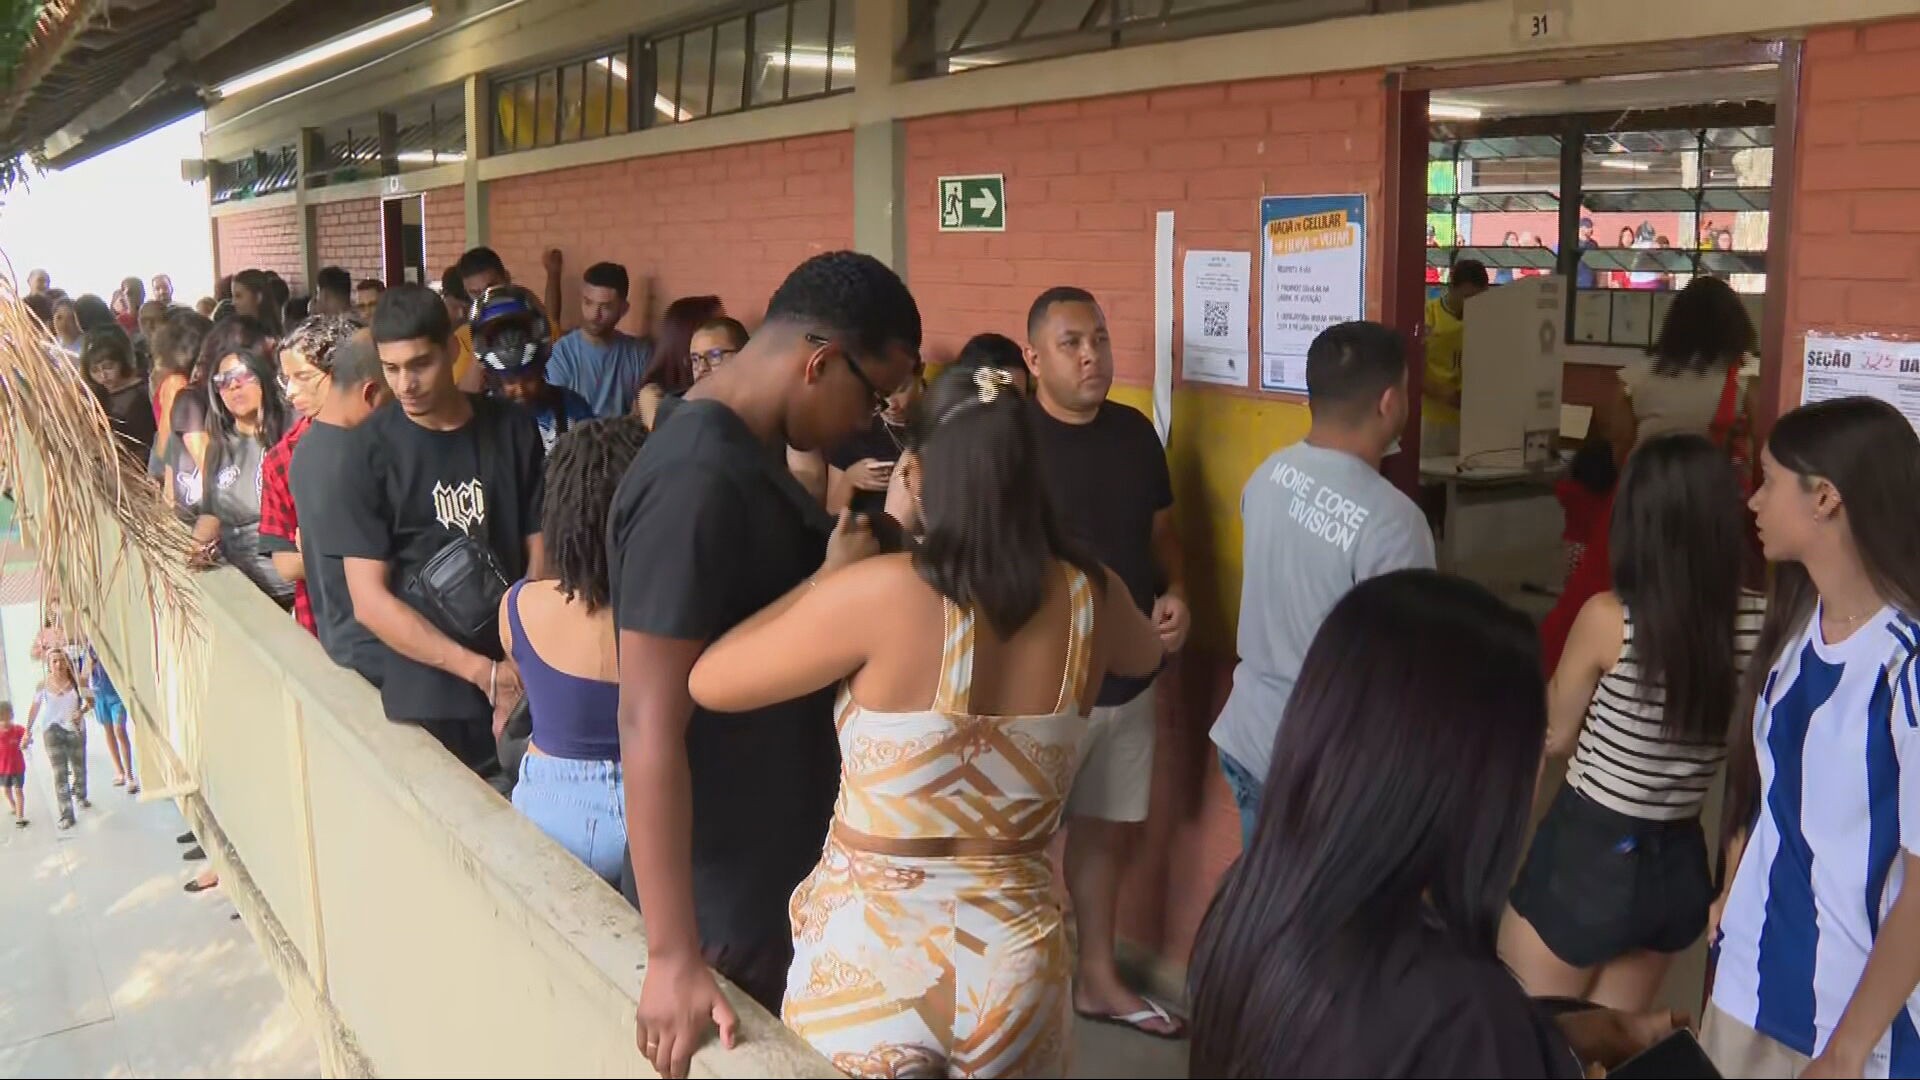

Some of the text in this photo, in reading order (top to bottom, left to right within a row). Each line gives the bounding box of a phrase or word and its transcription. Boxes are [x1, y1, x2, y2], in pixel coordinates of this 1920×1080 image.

[1531, 13, 1547, 36] 31
[1807, 350, 1851, 369] SEÇÃO
[1270, 461, 1370, 531] MORE CORE
[1288, 495, 1356, 553] DIVISION
